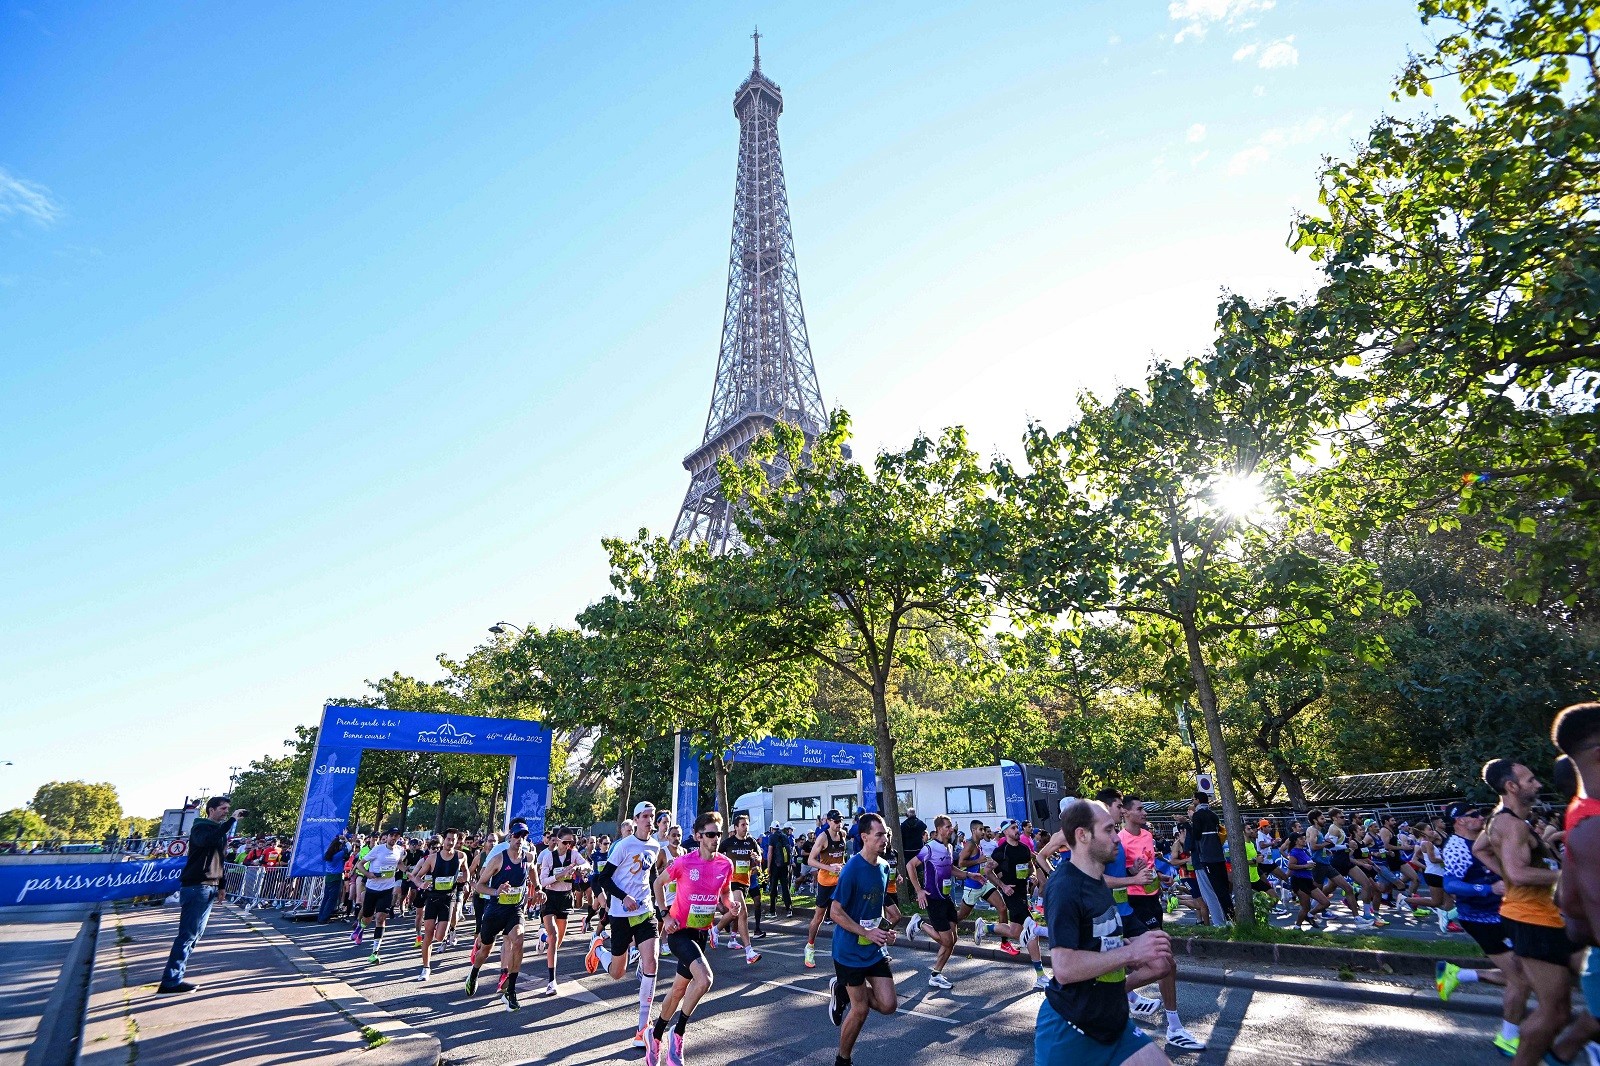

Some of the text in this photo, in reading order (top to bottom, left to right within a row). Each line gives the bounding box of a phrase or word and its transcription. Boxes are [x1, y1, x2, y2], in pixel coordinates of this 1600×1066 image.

[360, 718, 380, 729] garde
[343, 730, 364, 739] Bonne
[417, 734, 438, 743] Paris
[439, 735, 474, 746] Versailles
[503, 733, 526, 742] édition
[526, 735, 543, 744] 2025
[804, 744, 823, 755] Bonne
[802, 756, 822, 764] course
[328, 766, 356, 775] PARIS
[16, 862, 182, 902] parisversailles.co
